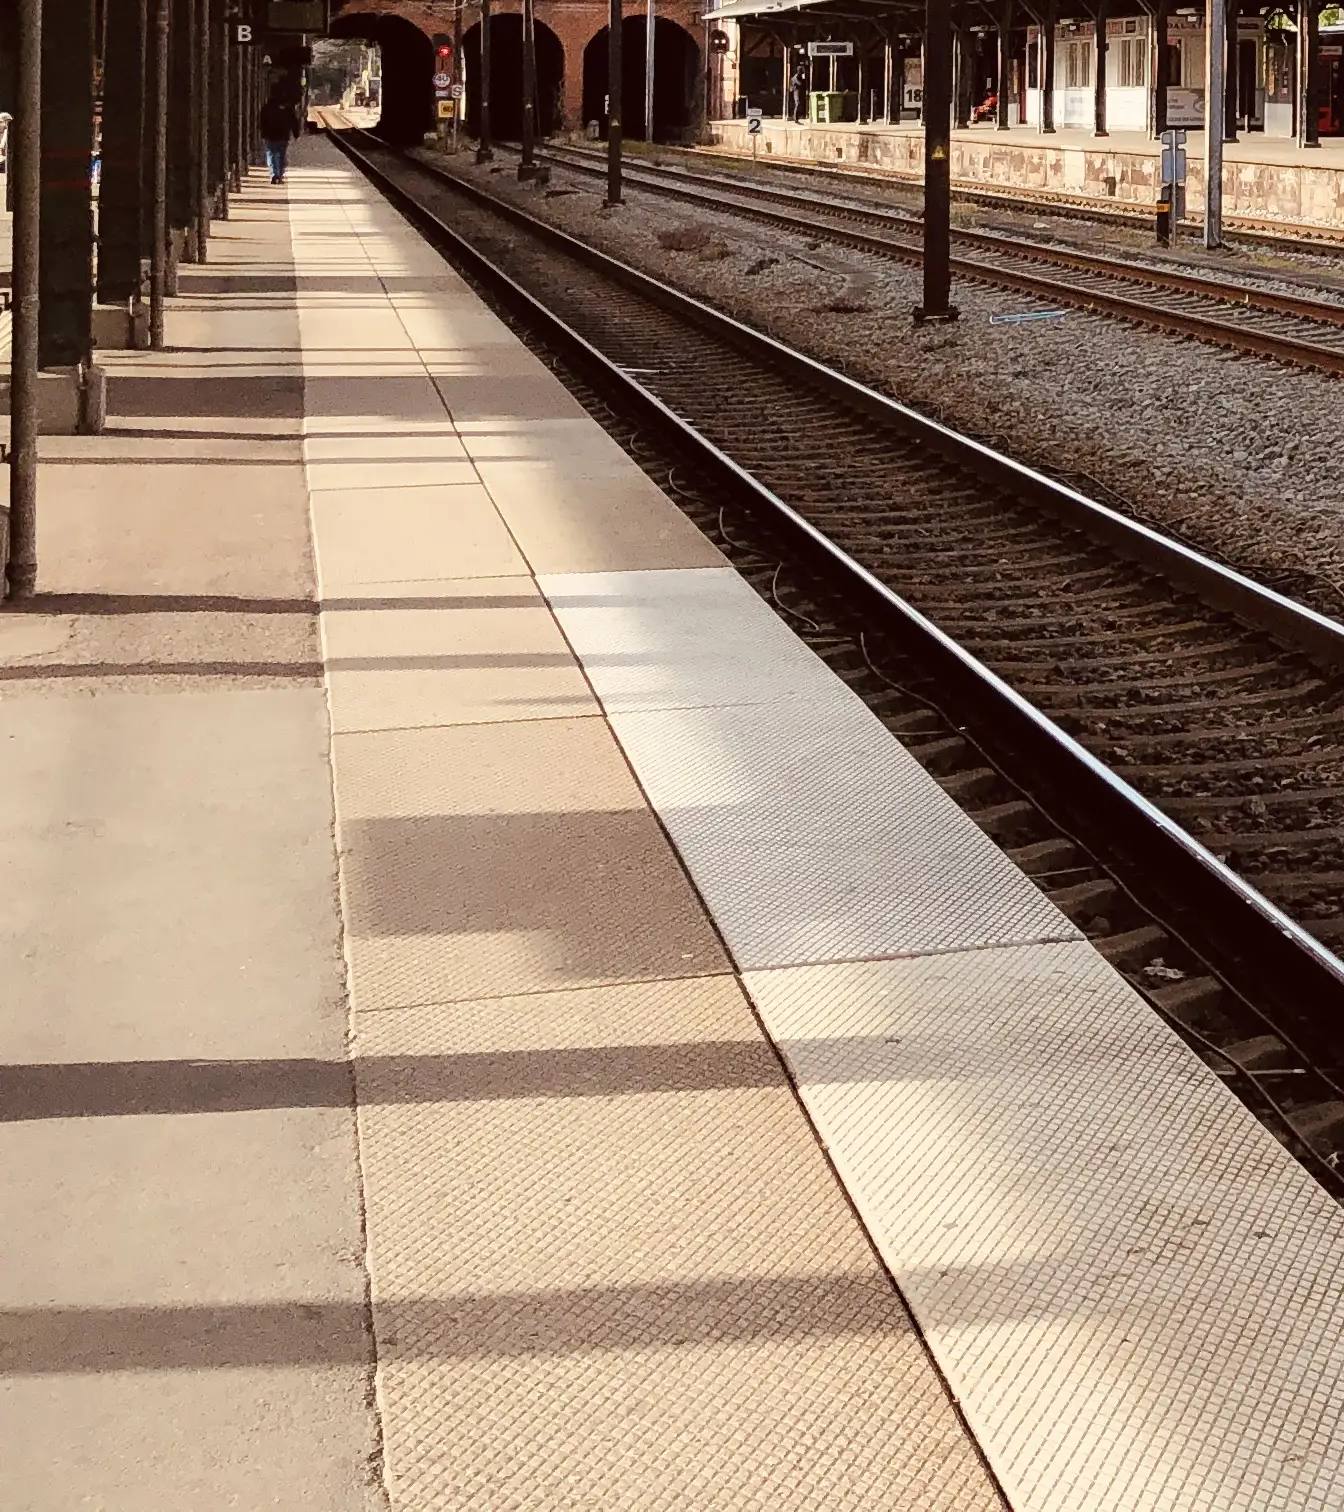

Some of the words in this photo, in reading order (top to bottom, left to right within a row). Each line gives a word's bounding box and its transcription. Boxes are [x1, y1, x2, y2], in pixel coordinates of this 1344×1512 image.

[237, 25, 252, 42] B
[263, 54, 272, 64] A
[452, 85, 463, 97] S
[749, 118, 761, 134] 2
